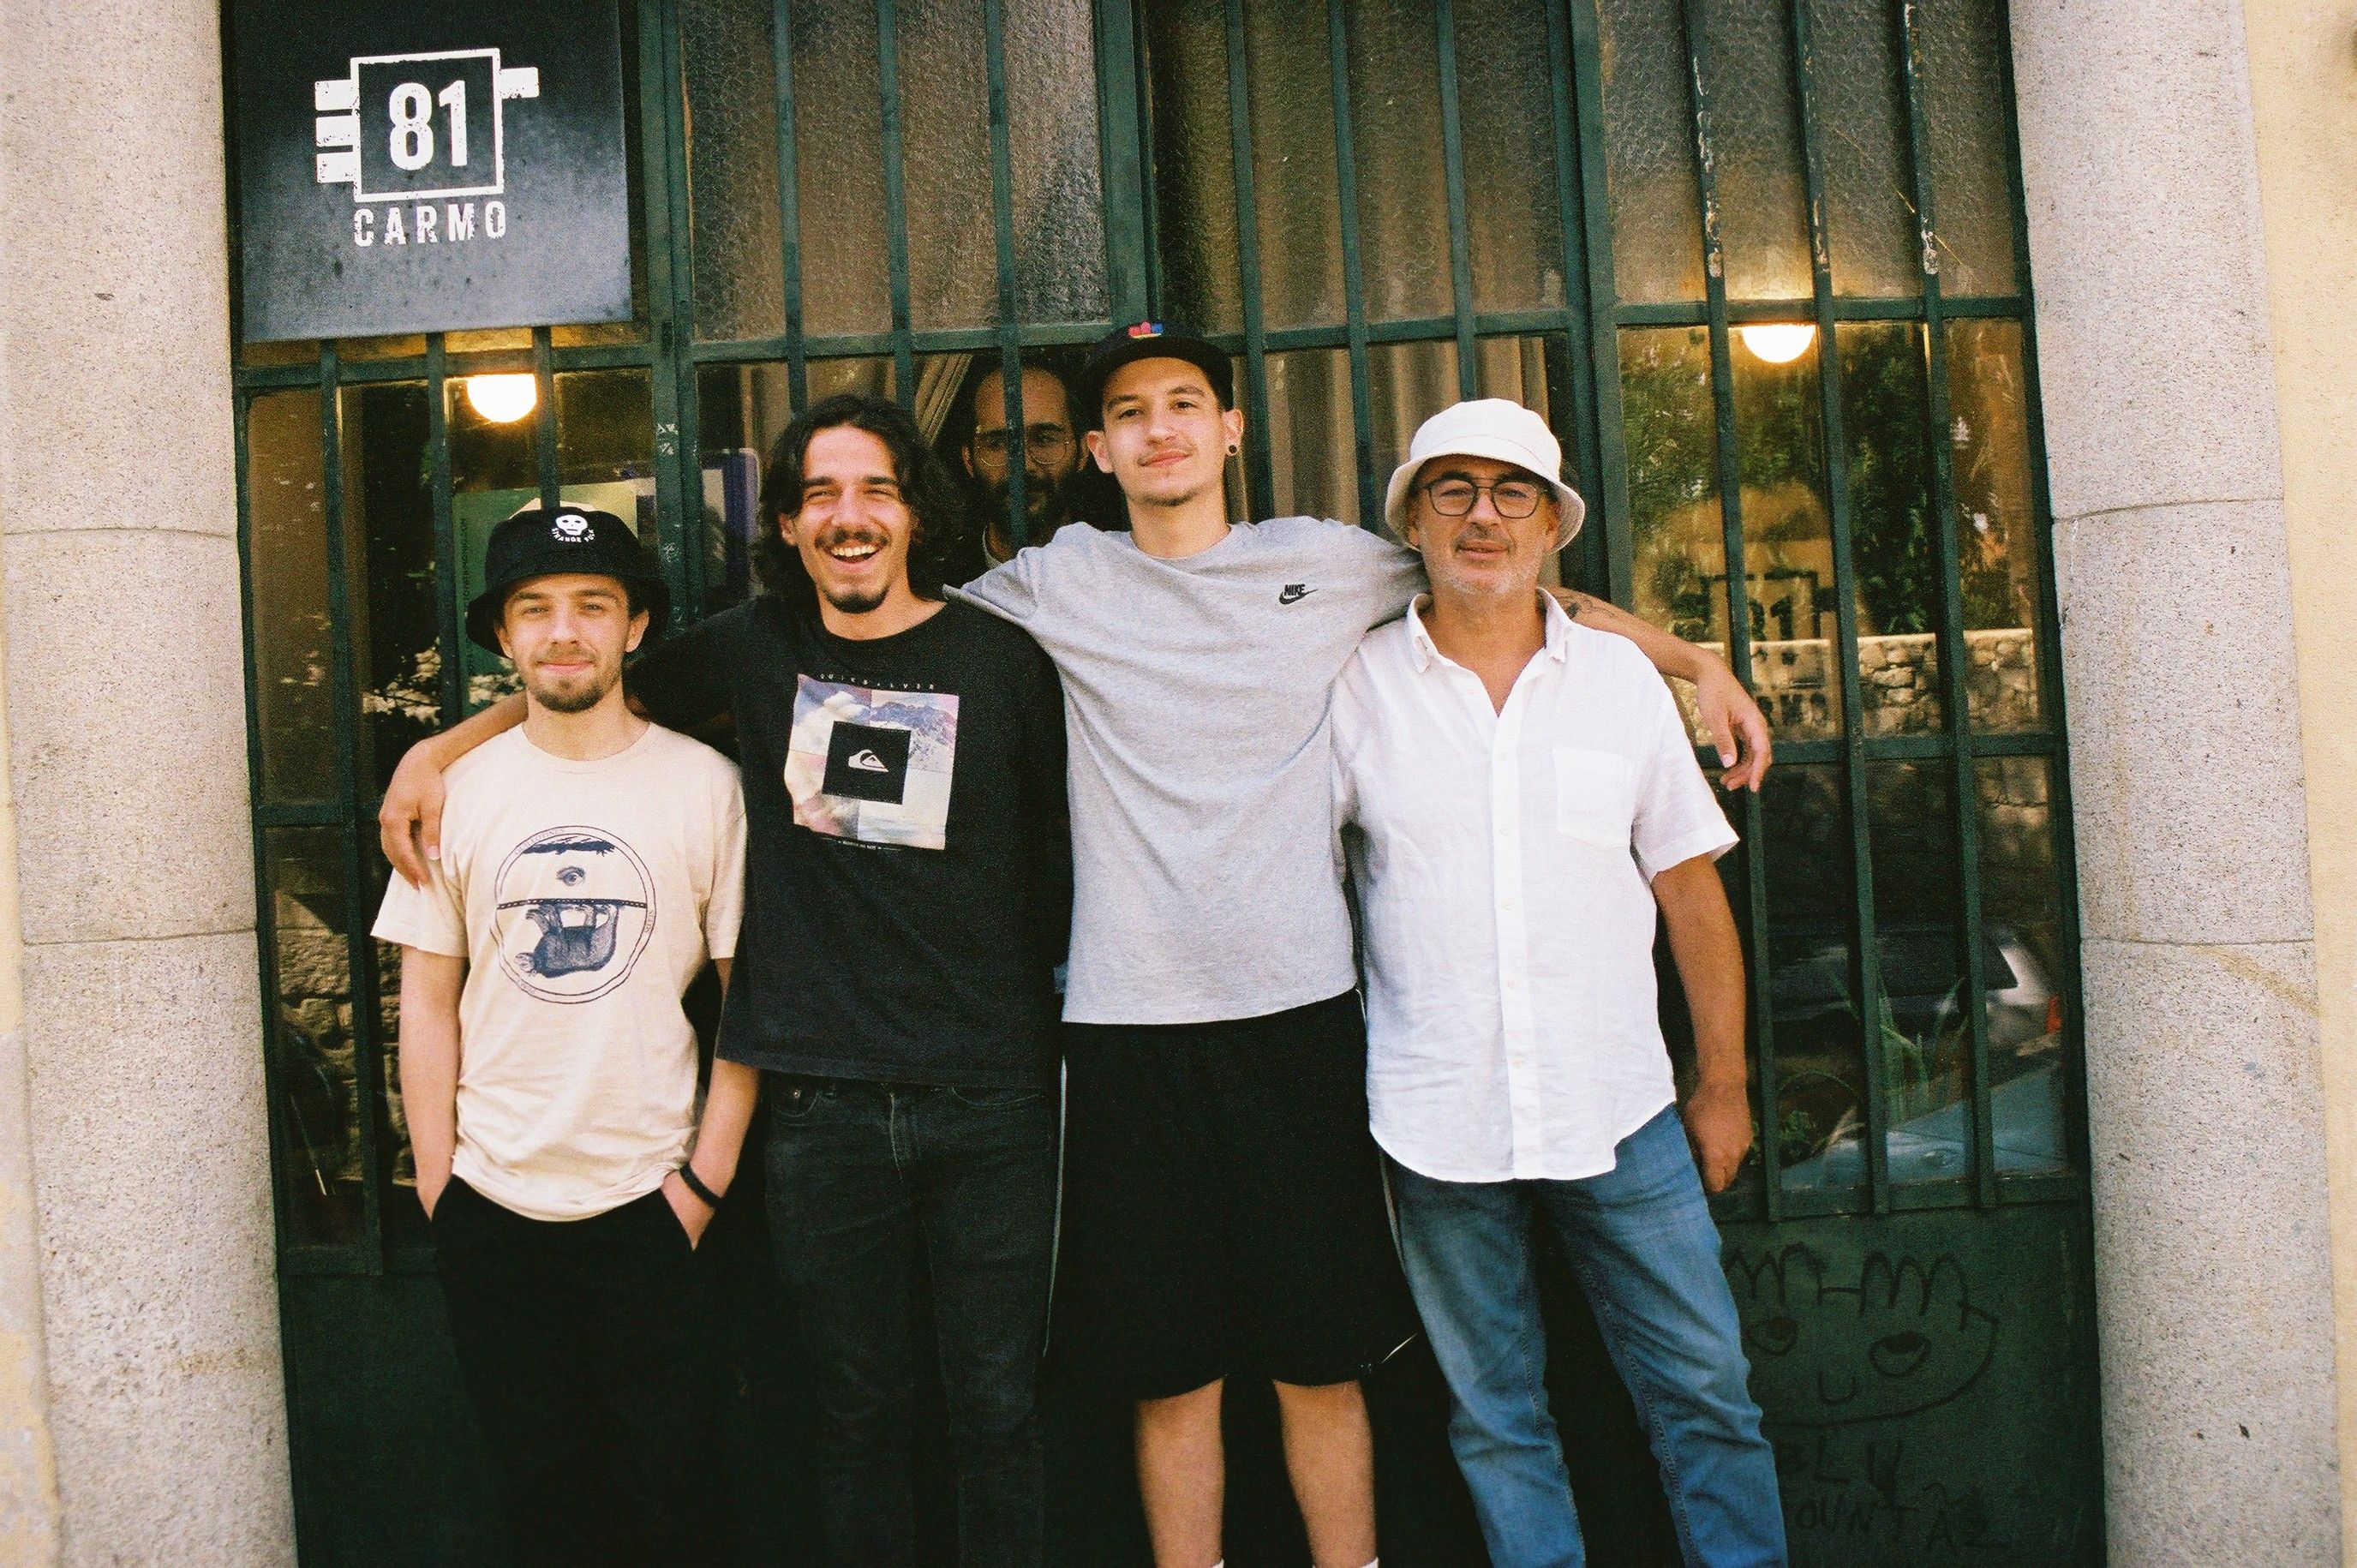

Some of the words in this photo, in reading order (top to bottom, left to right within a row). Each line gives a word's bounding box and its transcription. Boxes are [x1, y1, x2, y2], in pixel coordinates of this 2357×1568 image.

[388, 80, 468, 171] 81
[353, 200, 507, 248] CARMO
[551, 527, 582, 542] STRANGE
